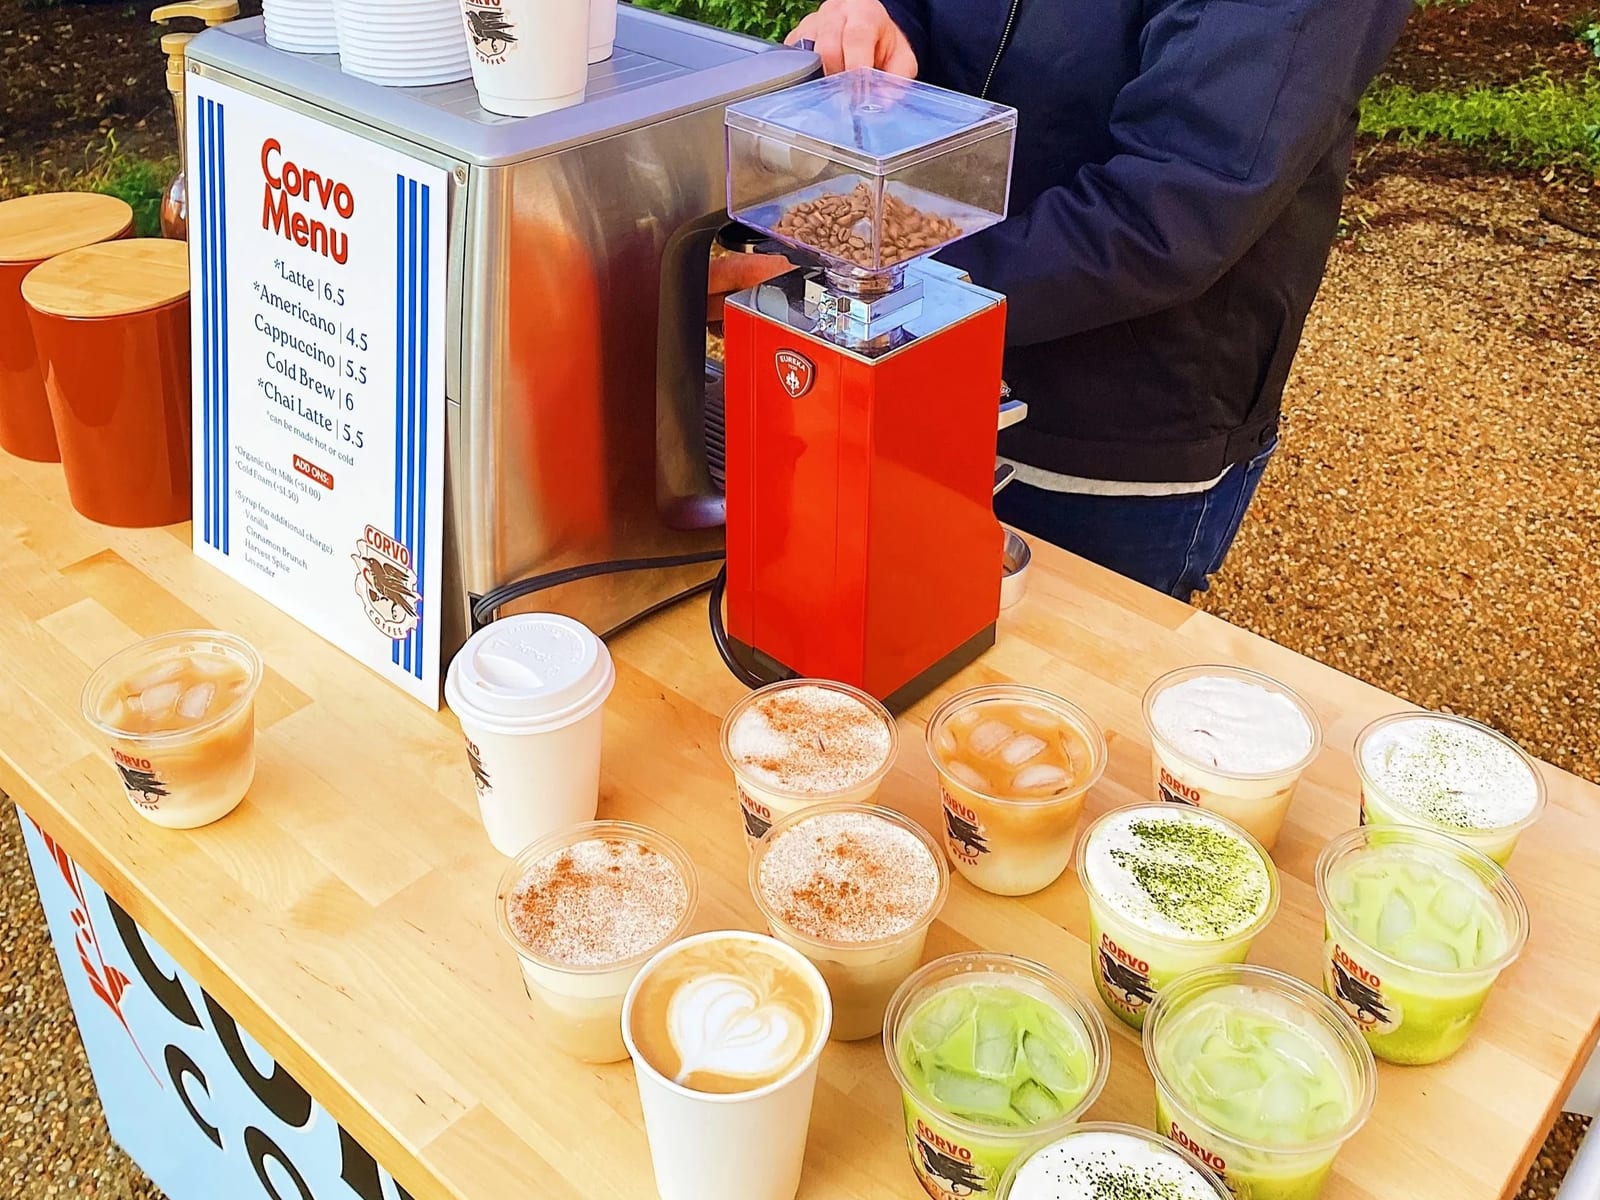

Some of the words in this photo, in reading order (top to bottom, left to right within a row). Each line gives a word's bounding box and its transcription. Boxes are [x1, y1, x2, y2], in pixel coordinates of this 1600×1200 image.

[261, 138, 354, 219] Corvo
[262, 182, 348, 265] Menu
[324, 282, 345, 306] 6.5
[254, 313, 335, 368] Cappuccino
[345, 359, 367, 384] 5.5
[346, 327, 368, 351] 4.5
[266, 351, 297, 381] Cold
[299, 367, 335, 400] Brew
[345, 392, 354, 411] 6
[779, 355, 806, 371] EUREKA
[297, 398, 332, 431] Latte
[342, 423, 364, 448] 5.5
[284, 419, 293, 432] be
[293, 426, 314, 443] made
[315, 437, 328, 452] hot
[328, 446, 337, 456] or
[338, 449, 354, 466] cold
[253, 470, 273, 488] Foam
[265, 461, 277, 475] Oat
[279, 468, 294, 485] Milk
[295, 458, 310, 473] ADD
[270, 512, 305, 537] additional
[244, 538, 271, 560] Harvest
[271, 555, 290, 574] Spice
[244, 552, 275, 578] Lavender
[246, 525, 281, 552] Cinnamon
[282, 546, 308, 570] Brunch
[366, 527, 408, 565] CORVO
[369, 609, 403, 636] COFFEE
[1161, 767, 1200, 801] CORVO
[1102, 931, 1149, 973] CORVO
[1335, 943, 1381, 988] CORVO
[917, 1119, 972, 1160] CORVO
[1171, 1121, 1226, 1170] CORVO
